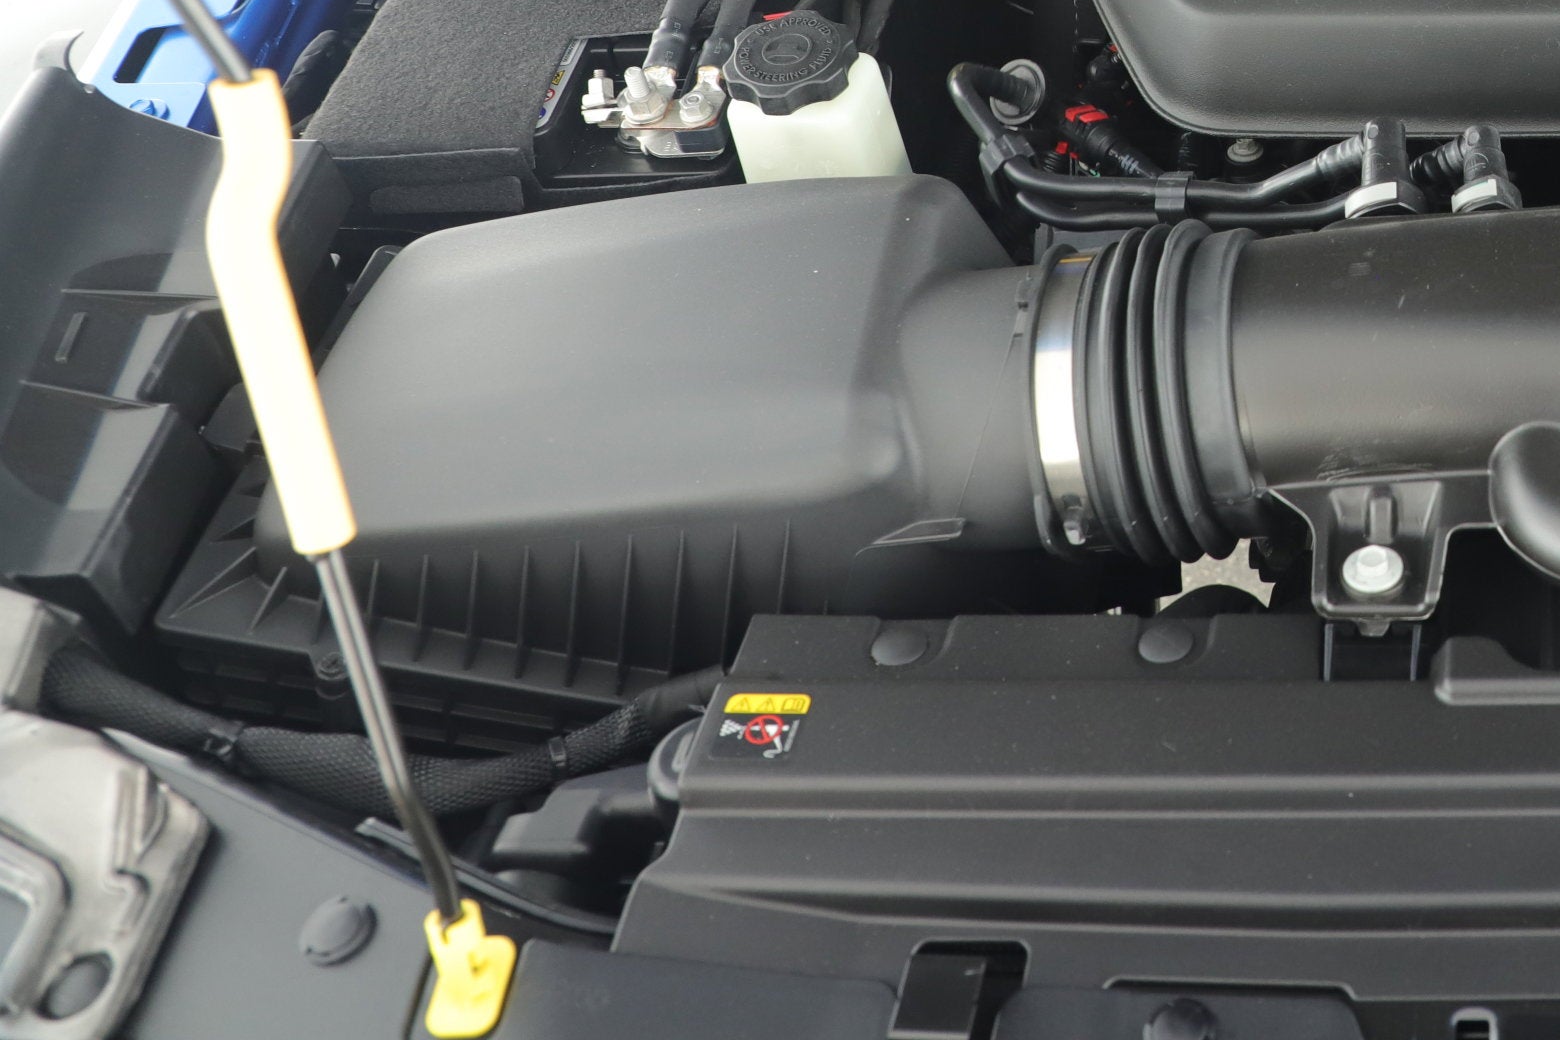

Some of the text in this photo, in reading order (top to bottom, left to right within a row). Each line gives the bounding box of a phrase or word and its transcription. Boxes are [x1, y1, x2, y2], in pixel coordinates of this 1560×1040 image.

[754, 16, 833, 37] USE APPROVED
[738, 46, 758, 76] POWER
[754, 68, 809, 82] STEERING
[808, 46, 833, 72] FLUID
